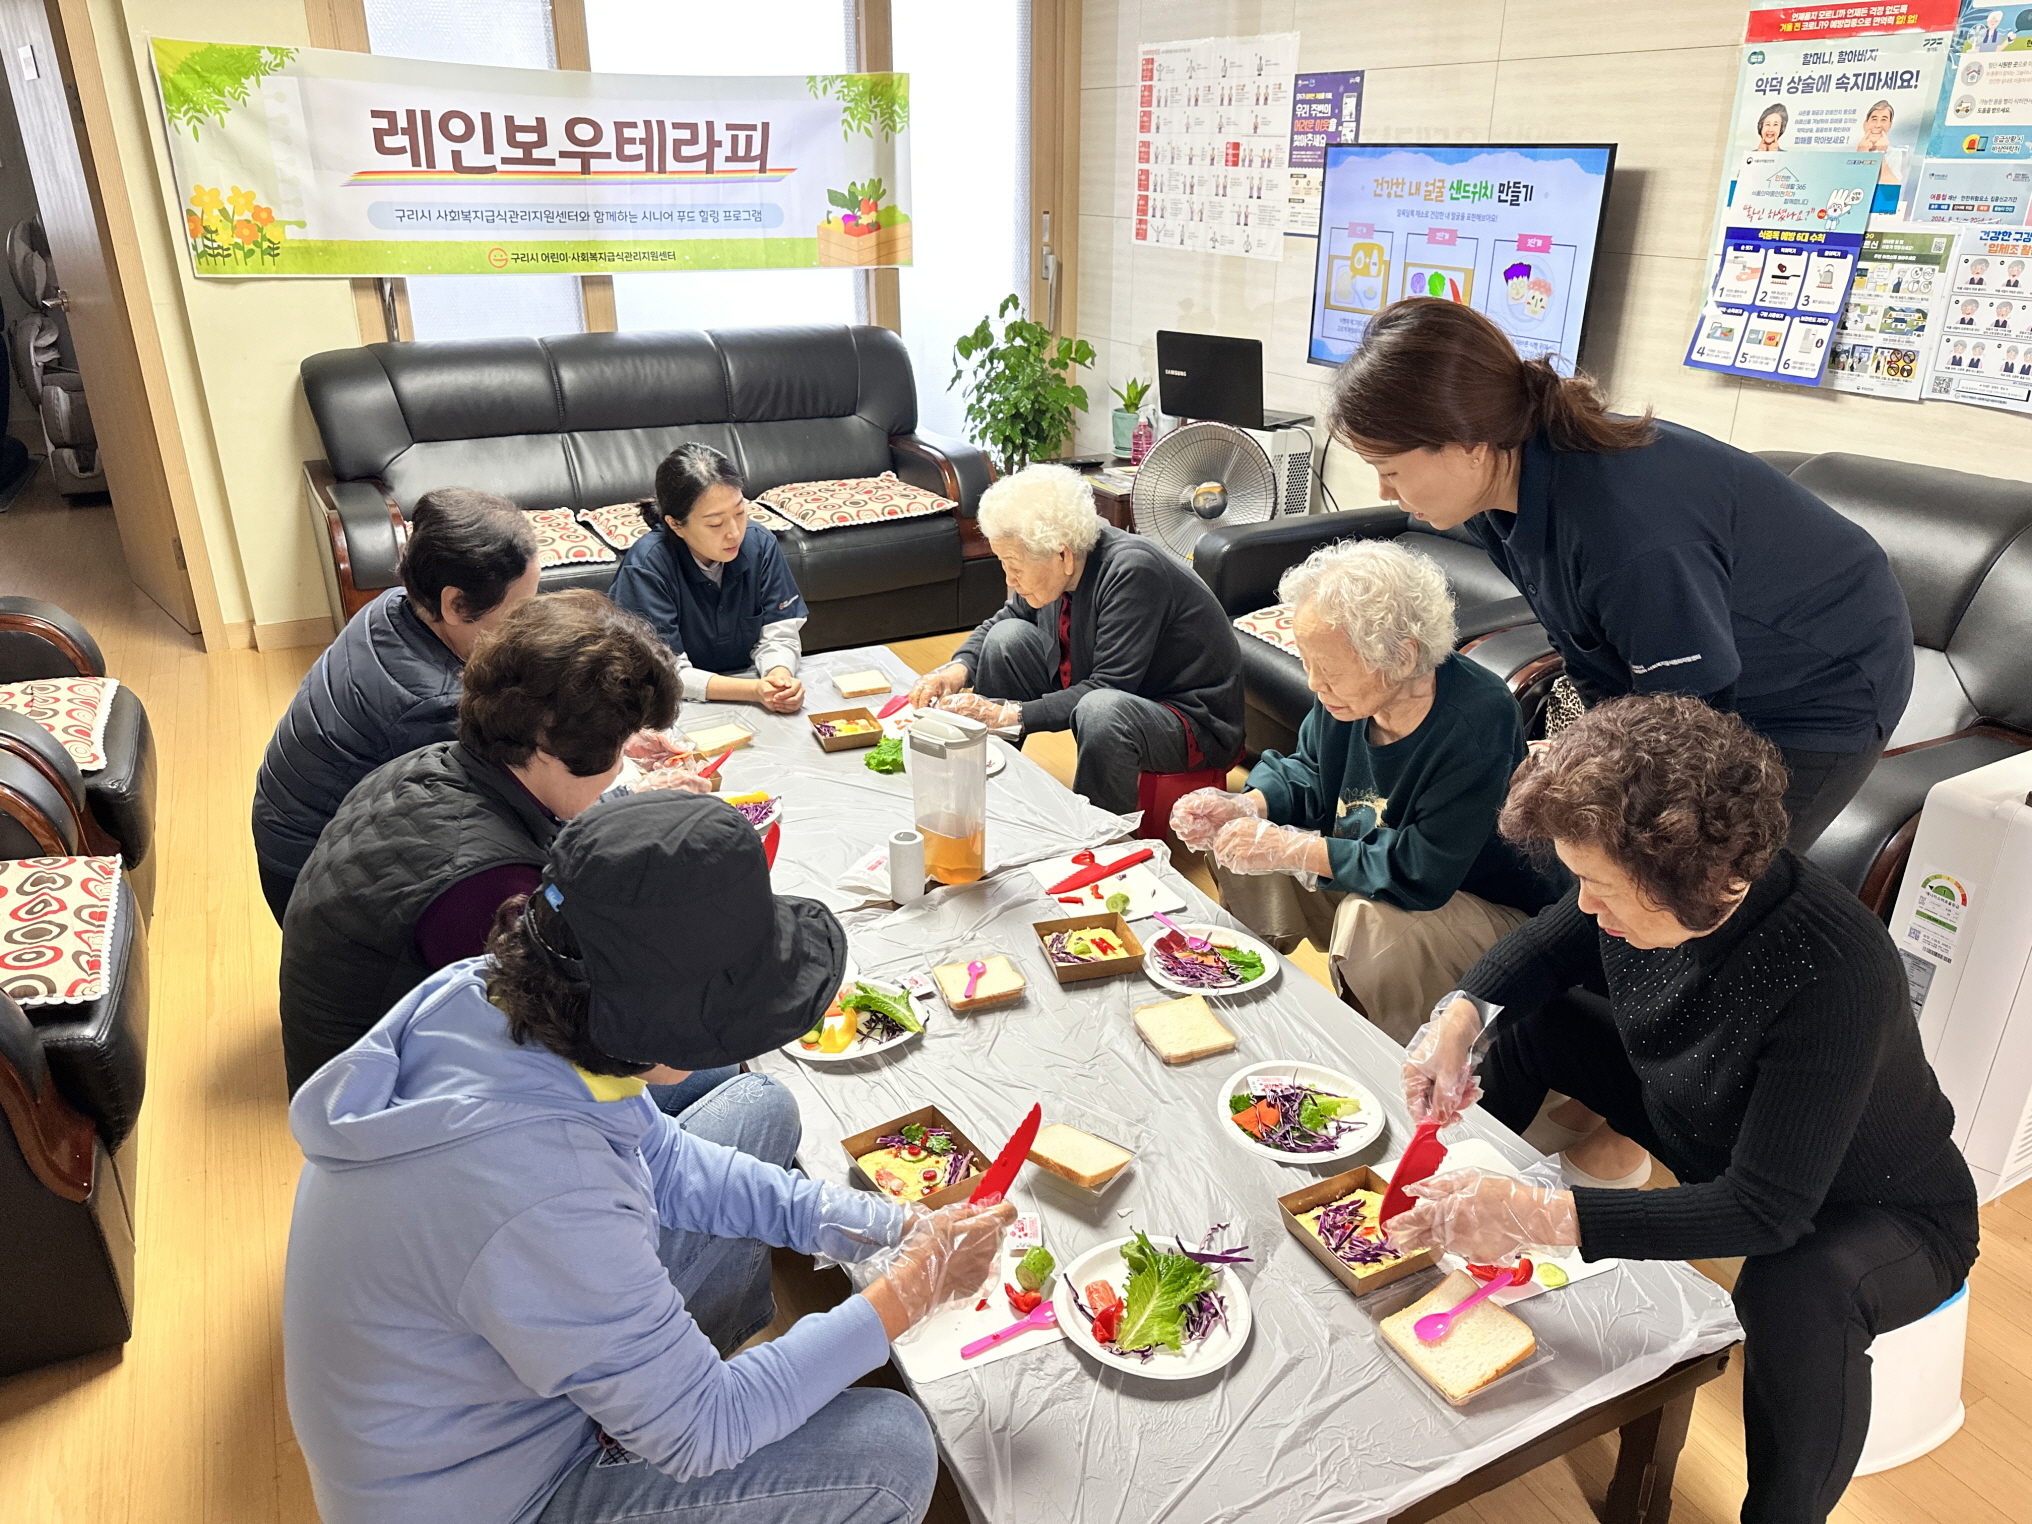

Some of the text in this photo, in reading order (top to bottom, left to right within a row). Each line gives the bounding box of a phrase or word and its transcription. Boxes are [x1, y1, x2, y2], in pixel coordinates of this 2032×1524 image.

[1817, 8, 1846, 20] 모르니까
[1847, 7, 1868, 18] 언제든
[1869, 6, 1884, 16] 걱정
[1885, 5, 1908, 15] 없도록
[1779, 14, 1918, 33] 겨울 전 코로나19 예방접종으로 면역력 업! 업!
[1802, 48, 1879, 66] 할머니, 할아버지
[1754, 70, 1921, 96] 악덕 상술에 속지마세요!
[1295, 104, 1309, 117] 우리
[1294, 118, 1337, 132] 어려운 이웃을
[370, 109, 770, 175] 레인보우테라피
[1293, 133, 1326, 147] 찾아주세요
[1794, 137, 1813, 145] 피해를
[1373, 176, 1534, 207] 건강한 내 얼굴 샌드위치 만들기
[394, 209, 762, 224] 구리시 사회복지급식관리지원센터와 함께하는 시니어 푸드 힐링 프로그램
[1430, 210, 1444, 220] 건강한
[1758, 230, 1826, 244] 식중독 예방 6대 수칙
[1979, 230, 2012, 242] 건강한
[1988, 243, 2032, 256] 입체조 활
[511, 251, 676, 263] 구리시 어린이·사회복지급식관리지원센터
[1718, 287, 1726, 298] 1
[1759, 291, 1768, 302] 2
[1801, 295, 1810, 306] 3
[1696, 346, 1705, 357] 4
[1739, 352, 1749, 363] 5
[1782, 358, 1791, 370] 6
[1165, 369, 1187, 377] SAMSUNG
